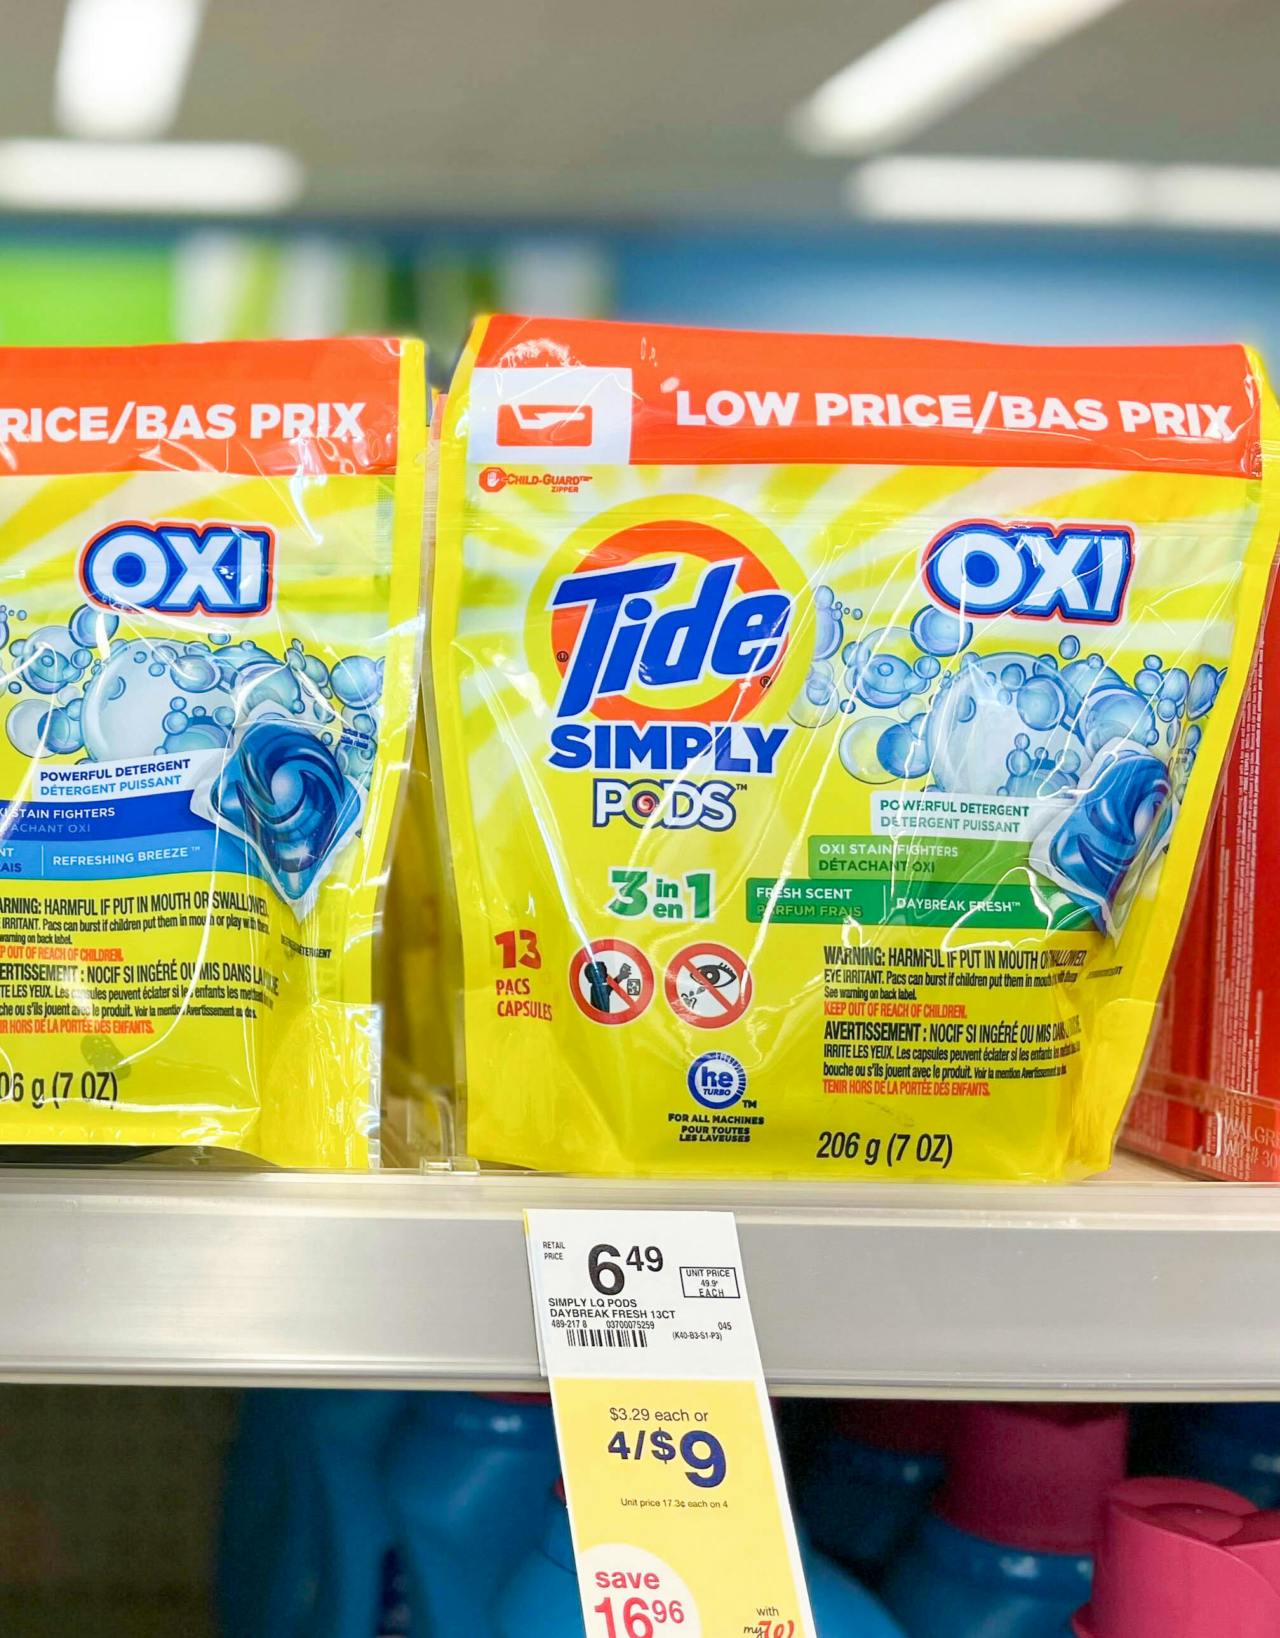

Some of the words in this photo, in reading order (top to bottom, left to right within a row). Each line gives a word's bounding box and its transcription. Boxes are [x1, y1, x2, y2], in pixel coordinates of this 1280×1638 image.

[251, 402, 365, 440] PRIX
[676, 389, 800, 427] LOW
[1120, 400, 1232, 442] PRIX
[95, 526, 269, 612] OXI
[927, 522, 1131, 619] OXI
[552, 562, 791, 718] Tide
[549, 724, 789, 773] SIMPLY
[40, 768, 112, 782] POWERFUL
[114, 758, 191, 777] DETERGENT
[40, 782, 116, 796] DÉTERGENT
[120, 775, 182, 791] PUISSANT
[53, 807, 116, 819] FIGHTERS
[880, 800, 958, 813] POWERFUL
[960, 803, 1030, 817] DETERGENT
[67, 823, 91, 833] OXI
[963, 819, 1020, 833] PUISSANT
[819, 843, 845, 855] OXI
[849, 844, 893, 856] STAIN
[897, 845, 959, 858] FIGHTERS
[53, 853, 135, 866] REFRESHING
[819, 857, 907, 872] DÉTACHANT
[912, 861, 935, 873] OXI
[608, 870, 648, 917] 3
[656, 878, 679, 898] in
[686, 873, 711, 919] 1
[805, 888, 853, 899] SCENT
[896, 897, 965, 911] DAYBREAK
[44, 899, 98, 916] HARMFUL
[113, 897, 135, 915] PUT
[151, 893, 190, 911] MOUTH
[653, 902, 683, 919] en
[820, 905, 862, 917] FRAIS
[494, 929, 542, 970] 13
[823, 946, 886, 966] WARNING:
[888, 948, 944, 968] HARMFUL
[960, 950, 982, 969] PUT
[999, 951, 1038, 969] MOUTH
[87, 965, 120, 983] NOCIF
[496, 978, 530, 996] PACS
[497, 1000, 553, 1022] CAPSULES
[881, 1003, 908, 1017] REACH
[824, 1021, 921, 1041] AVERTISSEMENT
[930, 1024, 963, 1042] NOCIF
[980, 1021, 1017, 1043] INGÉRÉ
[912, 1047, 948, 1063] capsules
[701, 1066, 734, 1088] he
[824, 1062, 853, 1076] bouche
[81, 1071, 118, 1109] OZ)
[703, 1088, 731, 1097] TURBO
[849, 1080, 872, 1094] HORS
[668, 1113, 690, 1122] FOR
[692, 1114, 710, 1123] ALL
[712, 1114, 764, 1125] MACHINES
[681, 1125, 709, 1134] POUR
[712, 1126, 750, 1135] TOUTES
[699, 1134, 751, 1143] LAVEUSES
[816, 1131, 860, 1159] 206
[864, 1138, 881, 1165] g
[886, 1133, 911, 1167] (7
[916, 1133, 953, 1169] OZ)
[543, 1241, 566, 1249] RETAIL
[544, 1252, 563, 1260] PRICE
[686, 1269, 705, 1277] UNIT
[706, 1269, 730, 1278] PRICE
[699, 1288, 725, 1297] EACH
[548, 1298, 587, 1307] SIMPLY
[590, 1299, 605, 1308] LQ
[608, 1299, 637, 1308] PODS
[550, 1309, 609, 1318] DAYBREAK
[612, 1310, 647, 1319] FRESH
[651, 1310, 676, 1319] 13CT
[606, 1321, 655, 1329] 03700075259
[609, 1407, 650, 1421] $3.29
[654, 1409, 690, 1422] each
[694, 1411, 708, 1422] or
[620, 1498, 638, 1507] Unit
[640, 1499, 661, 1508] price
[688, 1499, 708, 1508] each
[594, 1571, 660, 1590] save
[756, 1606, 779, 1617] with
